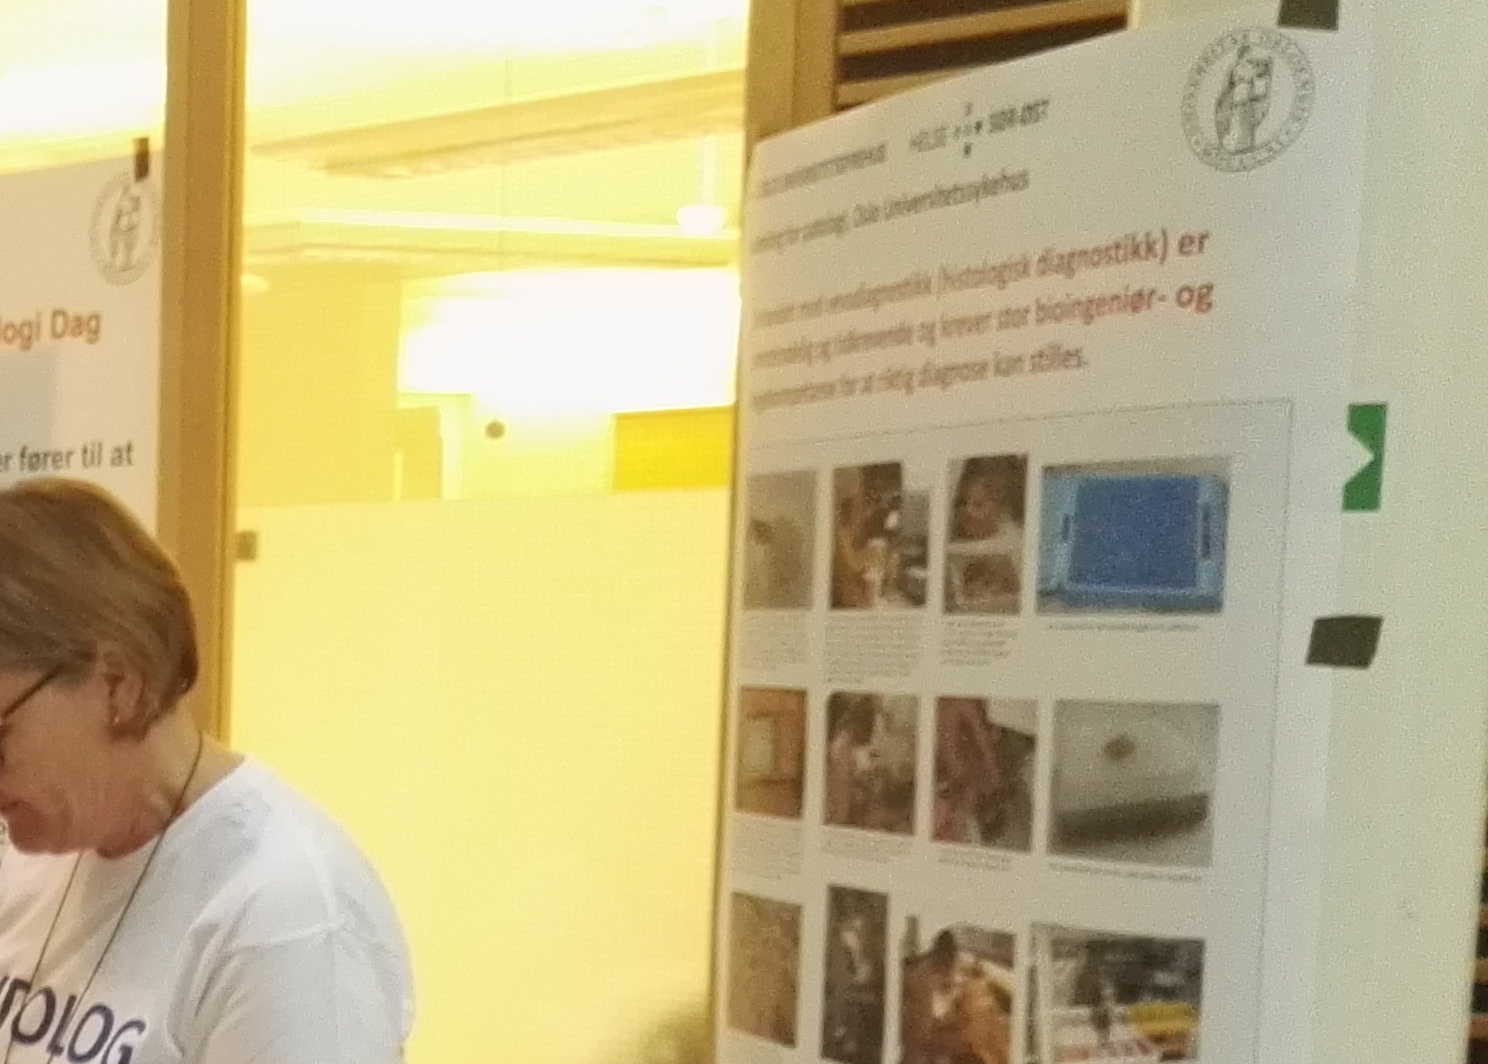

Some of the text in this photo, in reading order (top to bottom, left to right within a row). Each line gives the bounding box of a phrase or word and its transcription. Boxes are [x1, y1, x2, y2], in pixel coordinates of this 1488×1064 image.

[1037, 228, 1169, 280] diagnostikk)
[1178, 229, 1210, 256] er
[1036, 286, 1167, 326] bioingeniør-
[1175, 284, 1215, 315] og
[50, 308, 102, 346] Dag
[17, 444, 74, 474] fører
[81, 440, 103, 469] til
[110, 440, 134, 468] at
